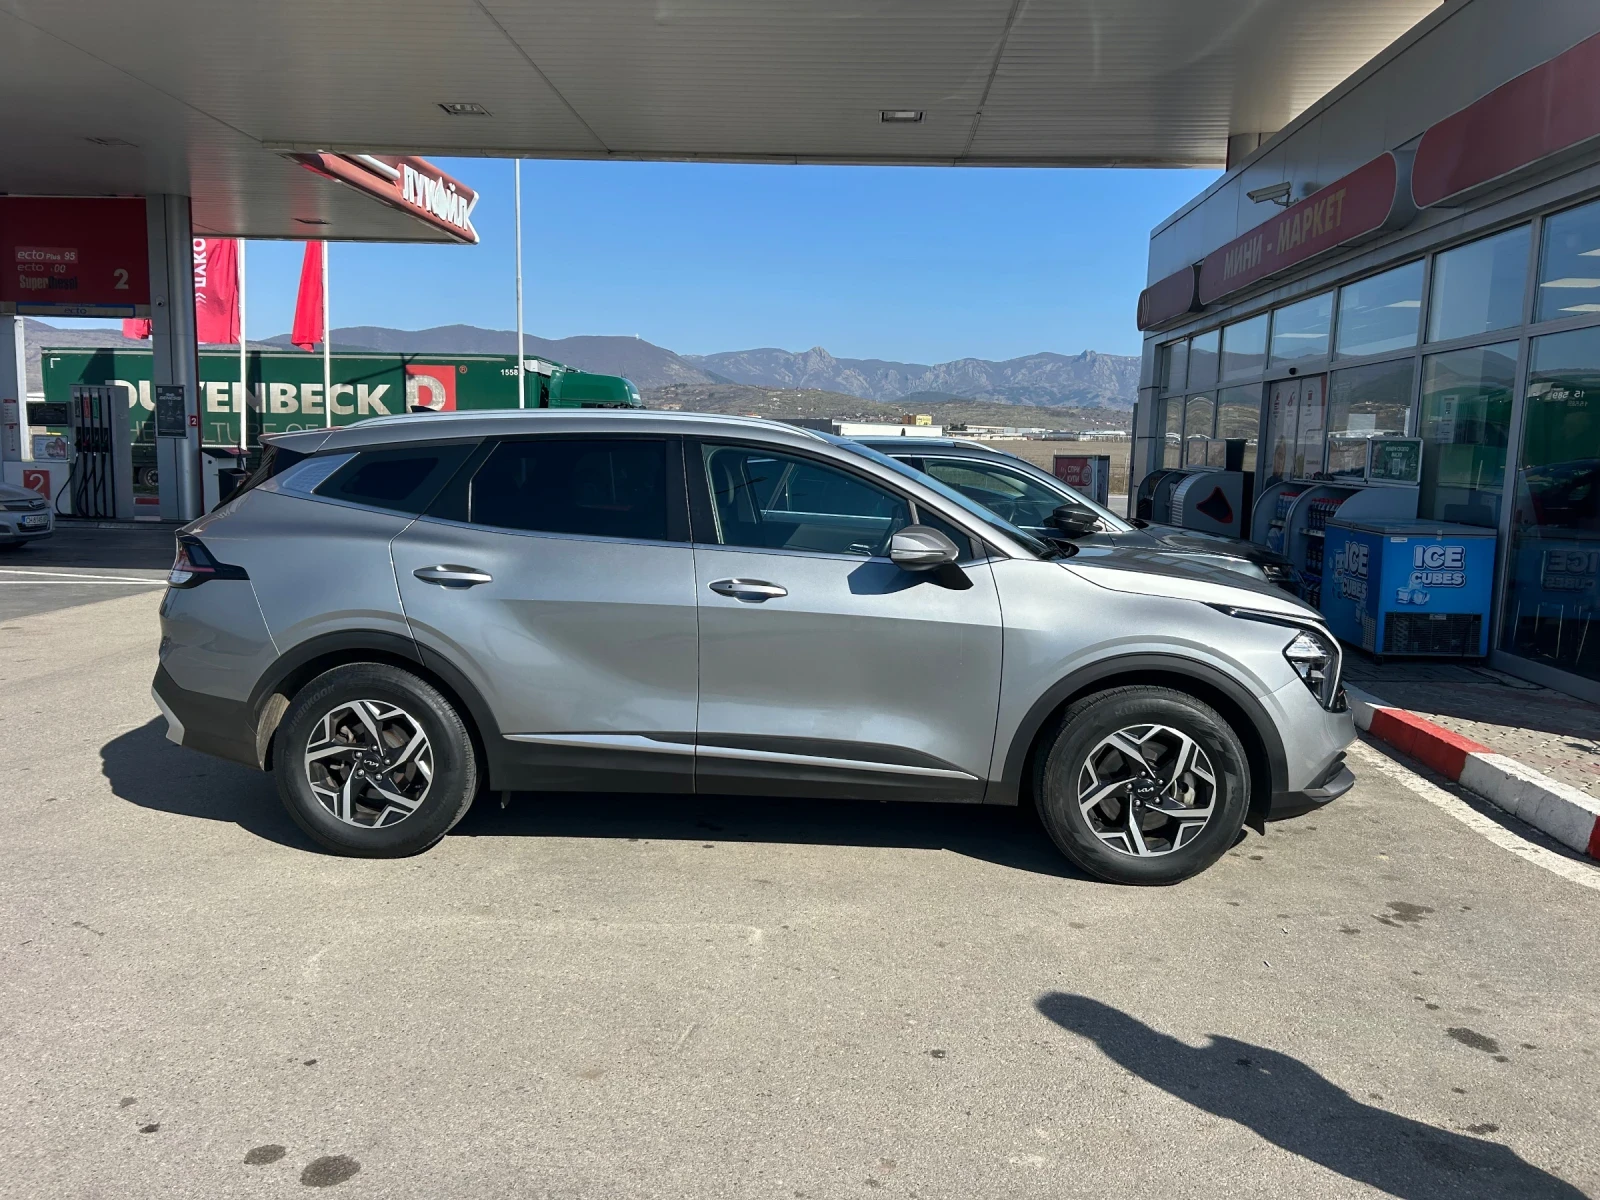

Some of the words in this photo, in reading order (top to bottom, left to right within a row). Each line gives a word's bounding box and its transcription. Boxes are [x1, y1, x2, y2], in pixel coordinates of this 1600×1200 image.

[1223, 234, 1263, 280] МИНИ
[1276, 187, 1346, 256] МАРКЕТ
[17, 249, 45, 260] ecto
[46, 253, 61, 261] Plus
[64, 251, 76, 261] 95
[17, 262, 44, 272] ecto
[113, 268, 129, 290] 2
[64, 306, 87, 315] ecto
[104, 379, 391, 415] DUENBECK
[405, 374, 447, 413] D
[191, 417, 197, 425] 2
[29, 473, 45, 497] 2
[1344, 541, 1369, 578] ICE
[1413, 544, 1465, 569] ICE
[1342, 577, 1368, 601] CUBES
[1410, 571, 1465, 587] CUBES
